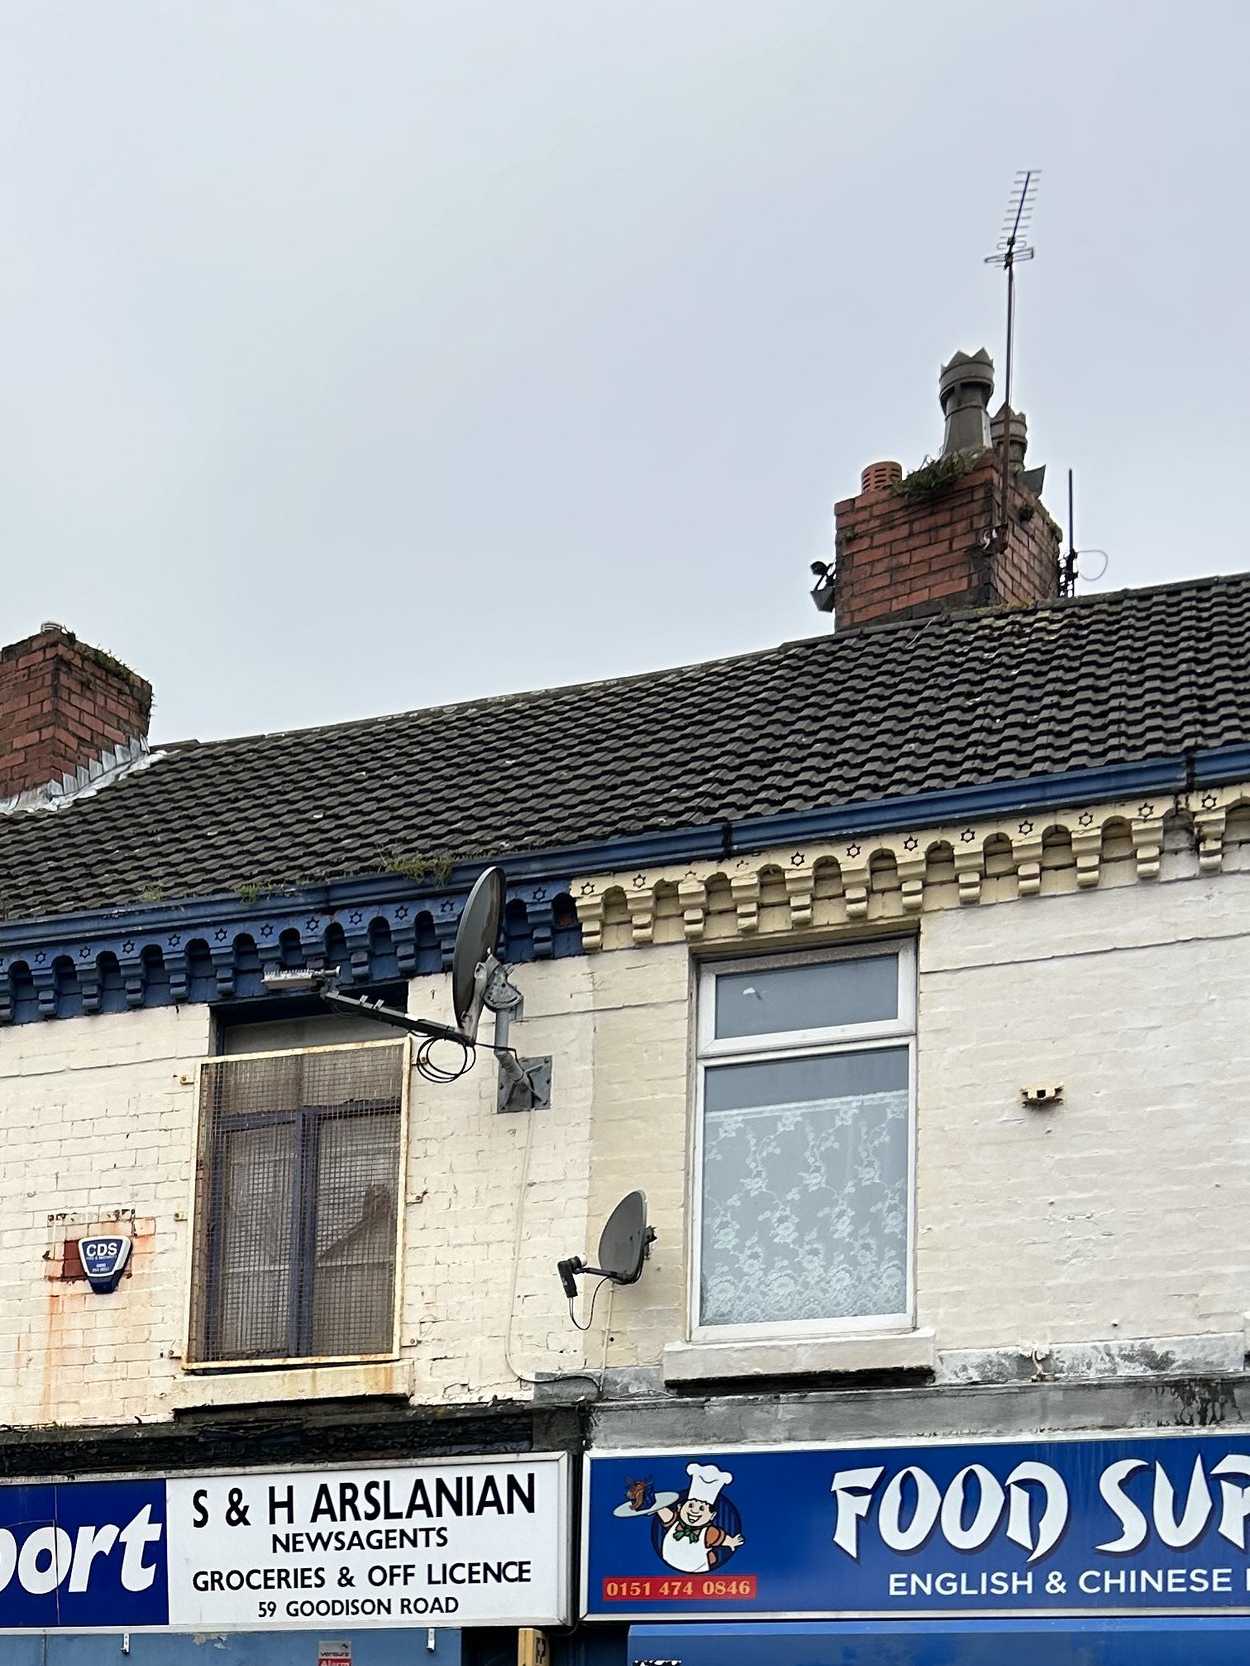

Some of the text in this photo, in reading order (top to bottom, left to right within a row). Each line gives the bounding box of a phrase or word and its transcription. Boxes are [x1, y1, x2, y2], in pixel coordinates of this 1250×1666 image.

[86, 1243, 118, 1257] CDS
[193, 1473, 535, 1528] S & H ARSLANIAN
[830, 1461, 1069, 1563] FOOD
[272, 1527, 448, 1553] NEWSAGENTS
[193, 1561, 532, 1592] GROCERIES & OFF LICENCE
[606, 1580, 750, 1596] 0151 474 0846
[889, 1571, 1034, 1596] ENGLISH
[1045, 1570, 1067, 1594] &
[1078, 1568, 1232, 1594] CHINESE
[258, 1597, 458, 1618] 59 GOODISON ROAD
